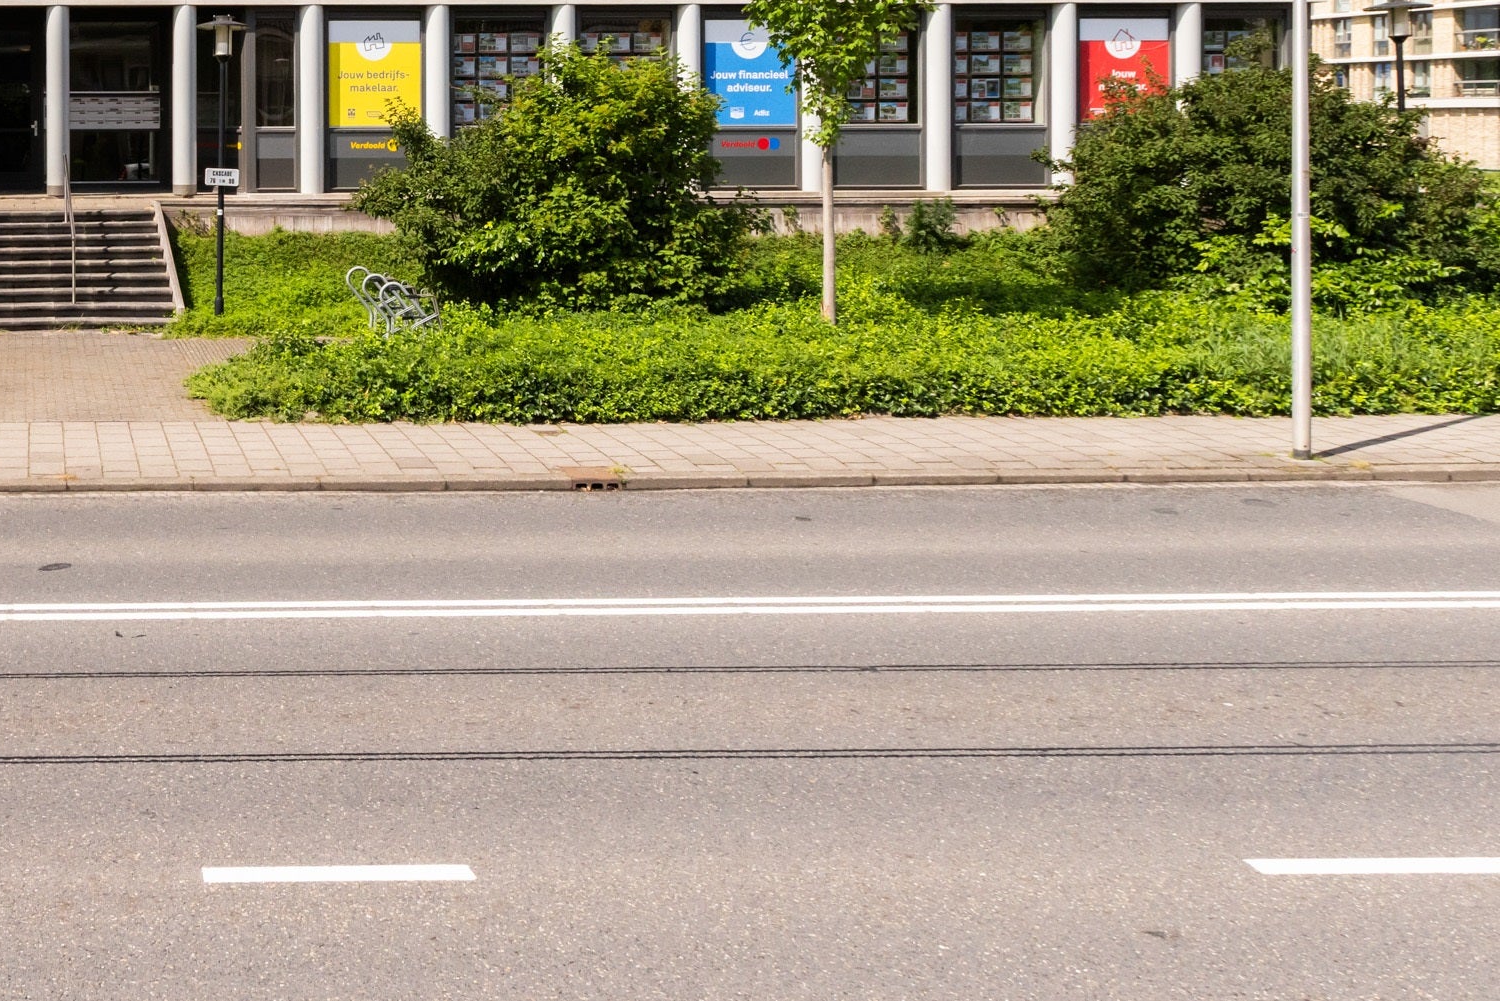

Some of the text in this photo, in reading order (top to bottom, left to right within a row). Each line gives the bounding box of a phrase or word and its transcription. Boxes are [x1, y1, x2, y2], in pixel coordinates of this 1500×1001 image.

[338, 70, 410, 81] Jouw bedrijfs-
[710, 70, 788, 79] Jouw financieel
[350, 83, 399, 92] makelaar.
[727, 83, 772, 92] adviseur.
